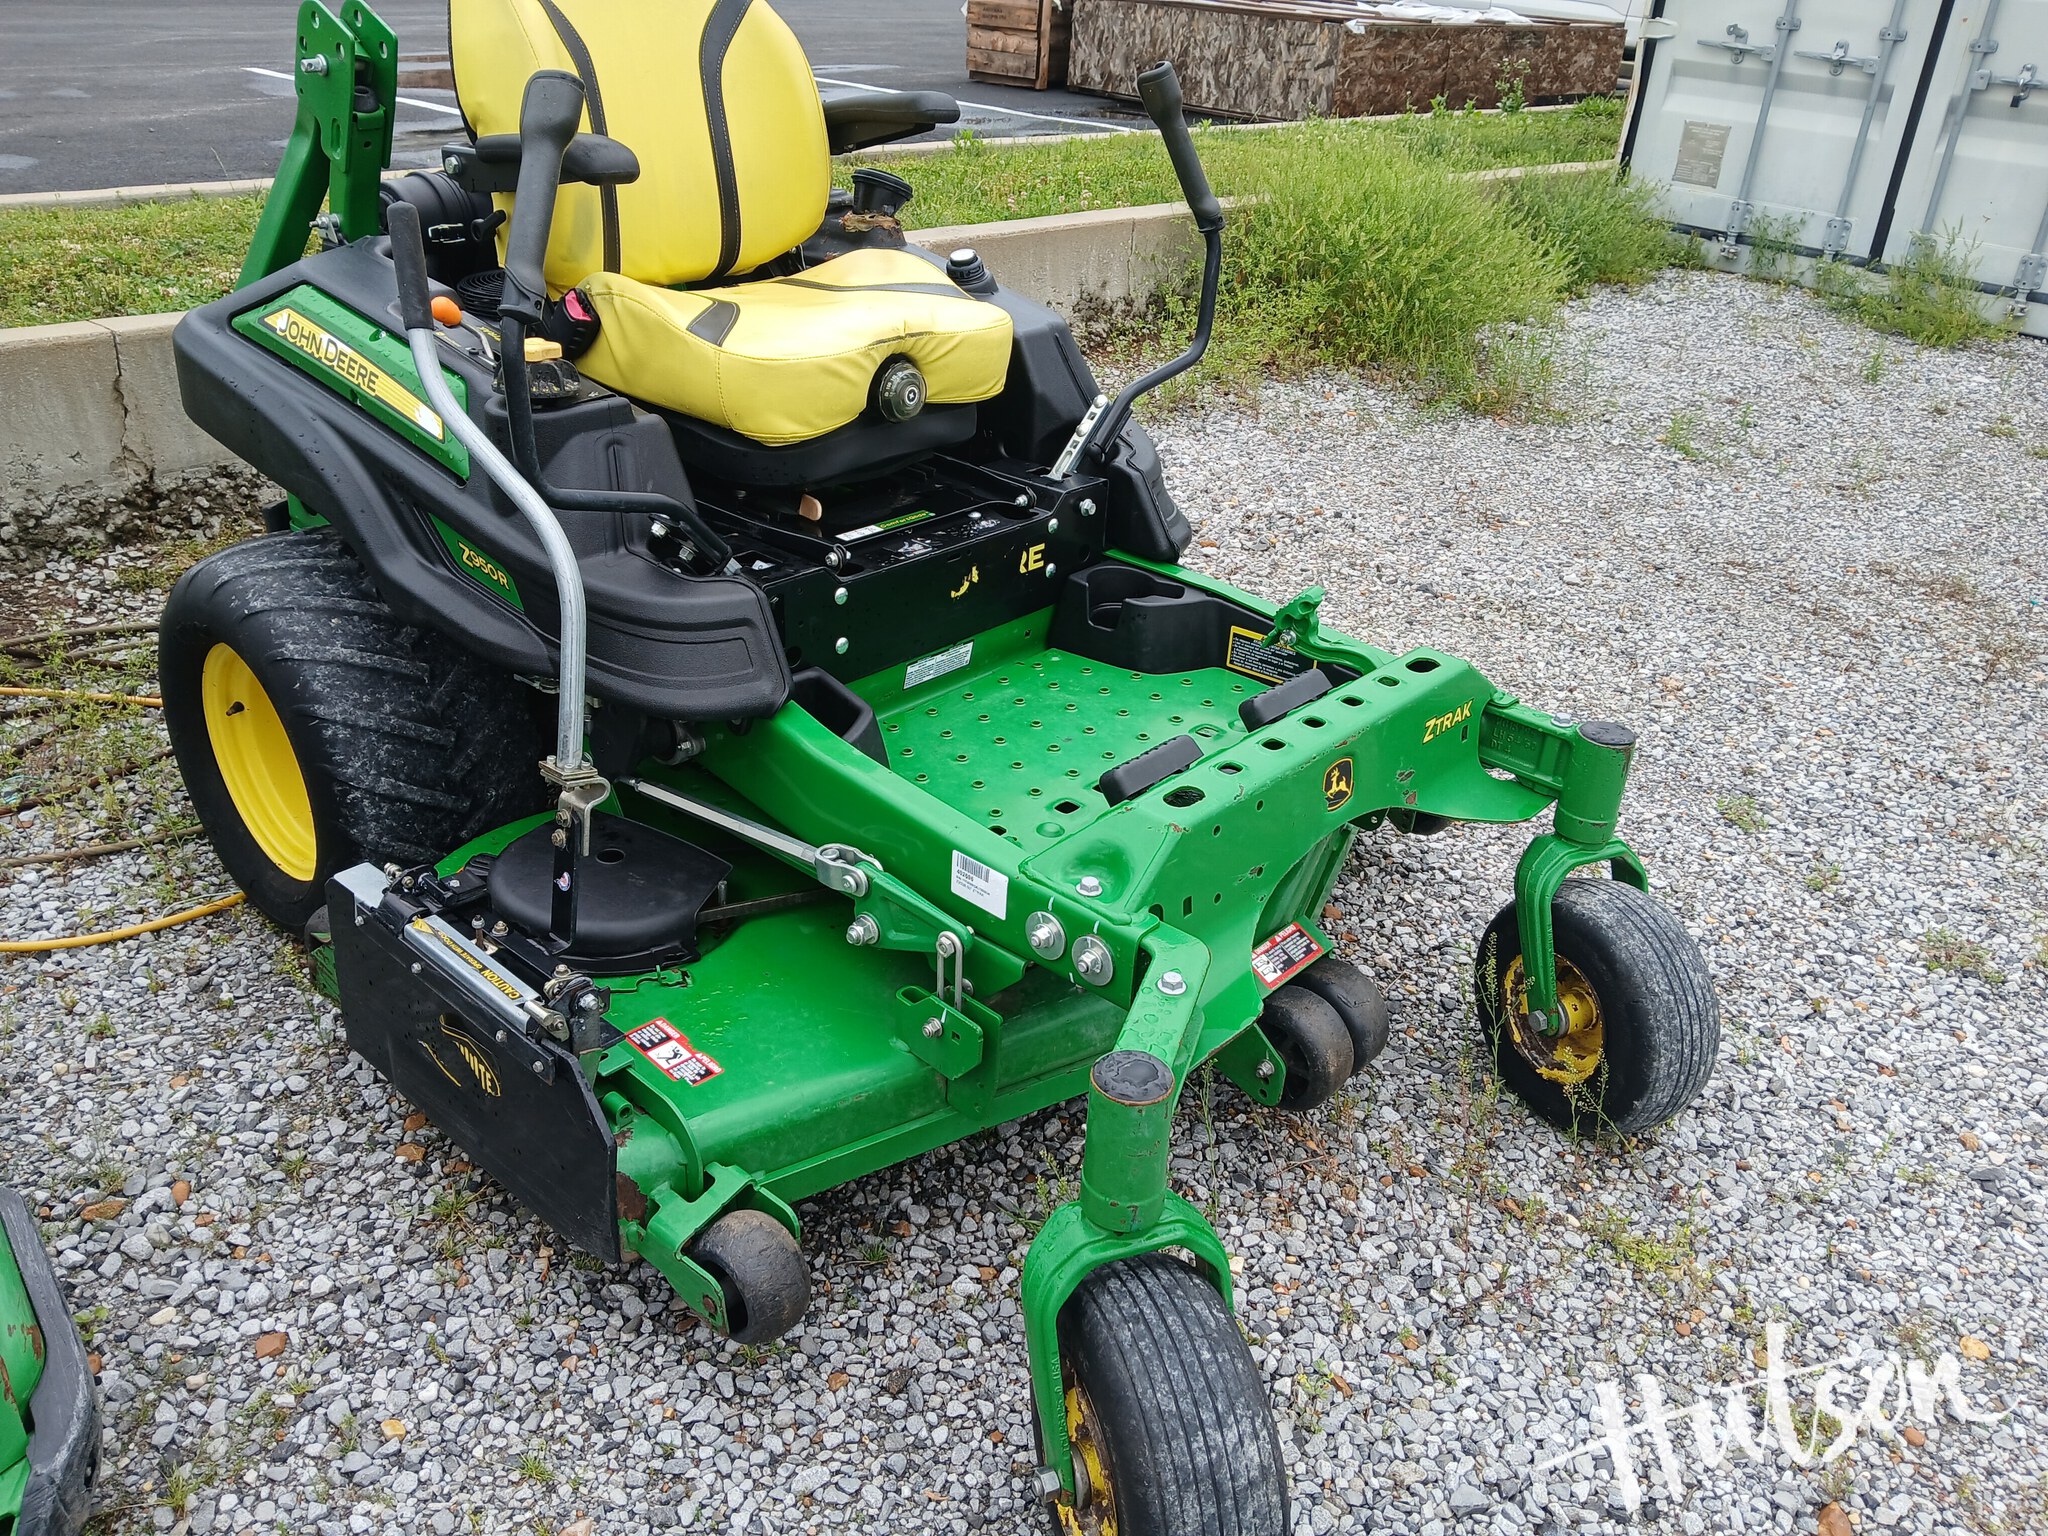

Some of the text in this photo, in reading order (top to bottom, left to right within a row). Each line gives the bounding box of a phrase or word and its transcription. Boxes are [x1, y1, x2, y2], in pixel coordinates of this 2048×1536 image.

[279, 312, 380, 394] JOHN DEERE
[458, 541, 510, 590] Z950R
[1422, 698, 1474, 745] ZTRAK
[481, 969, 521, 1000] CAUTION
[661, 1021, 681, 1040] DANGER
[700, 1053, 722, 1074] PELIGRO
